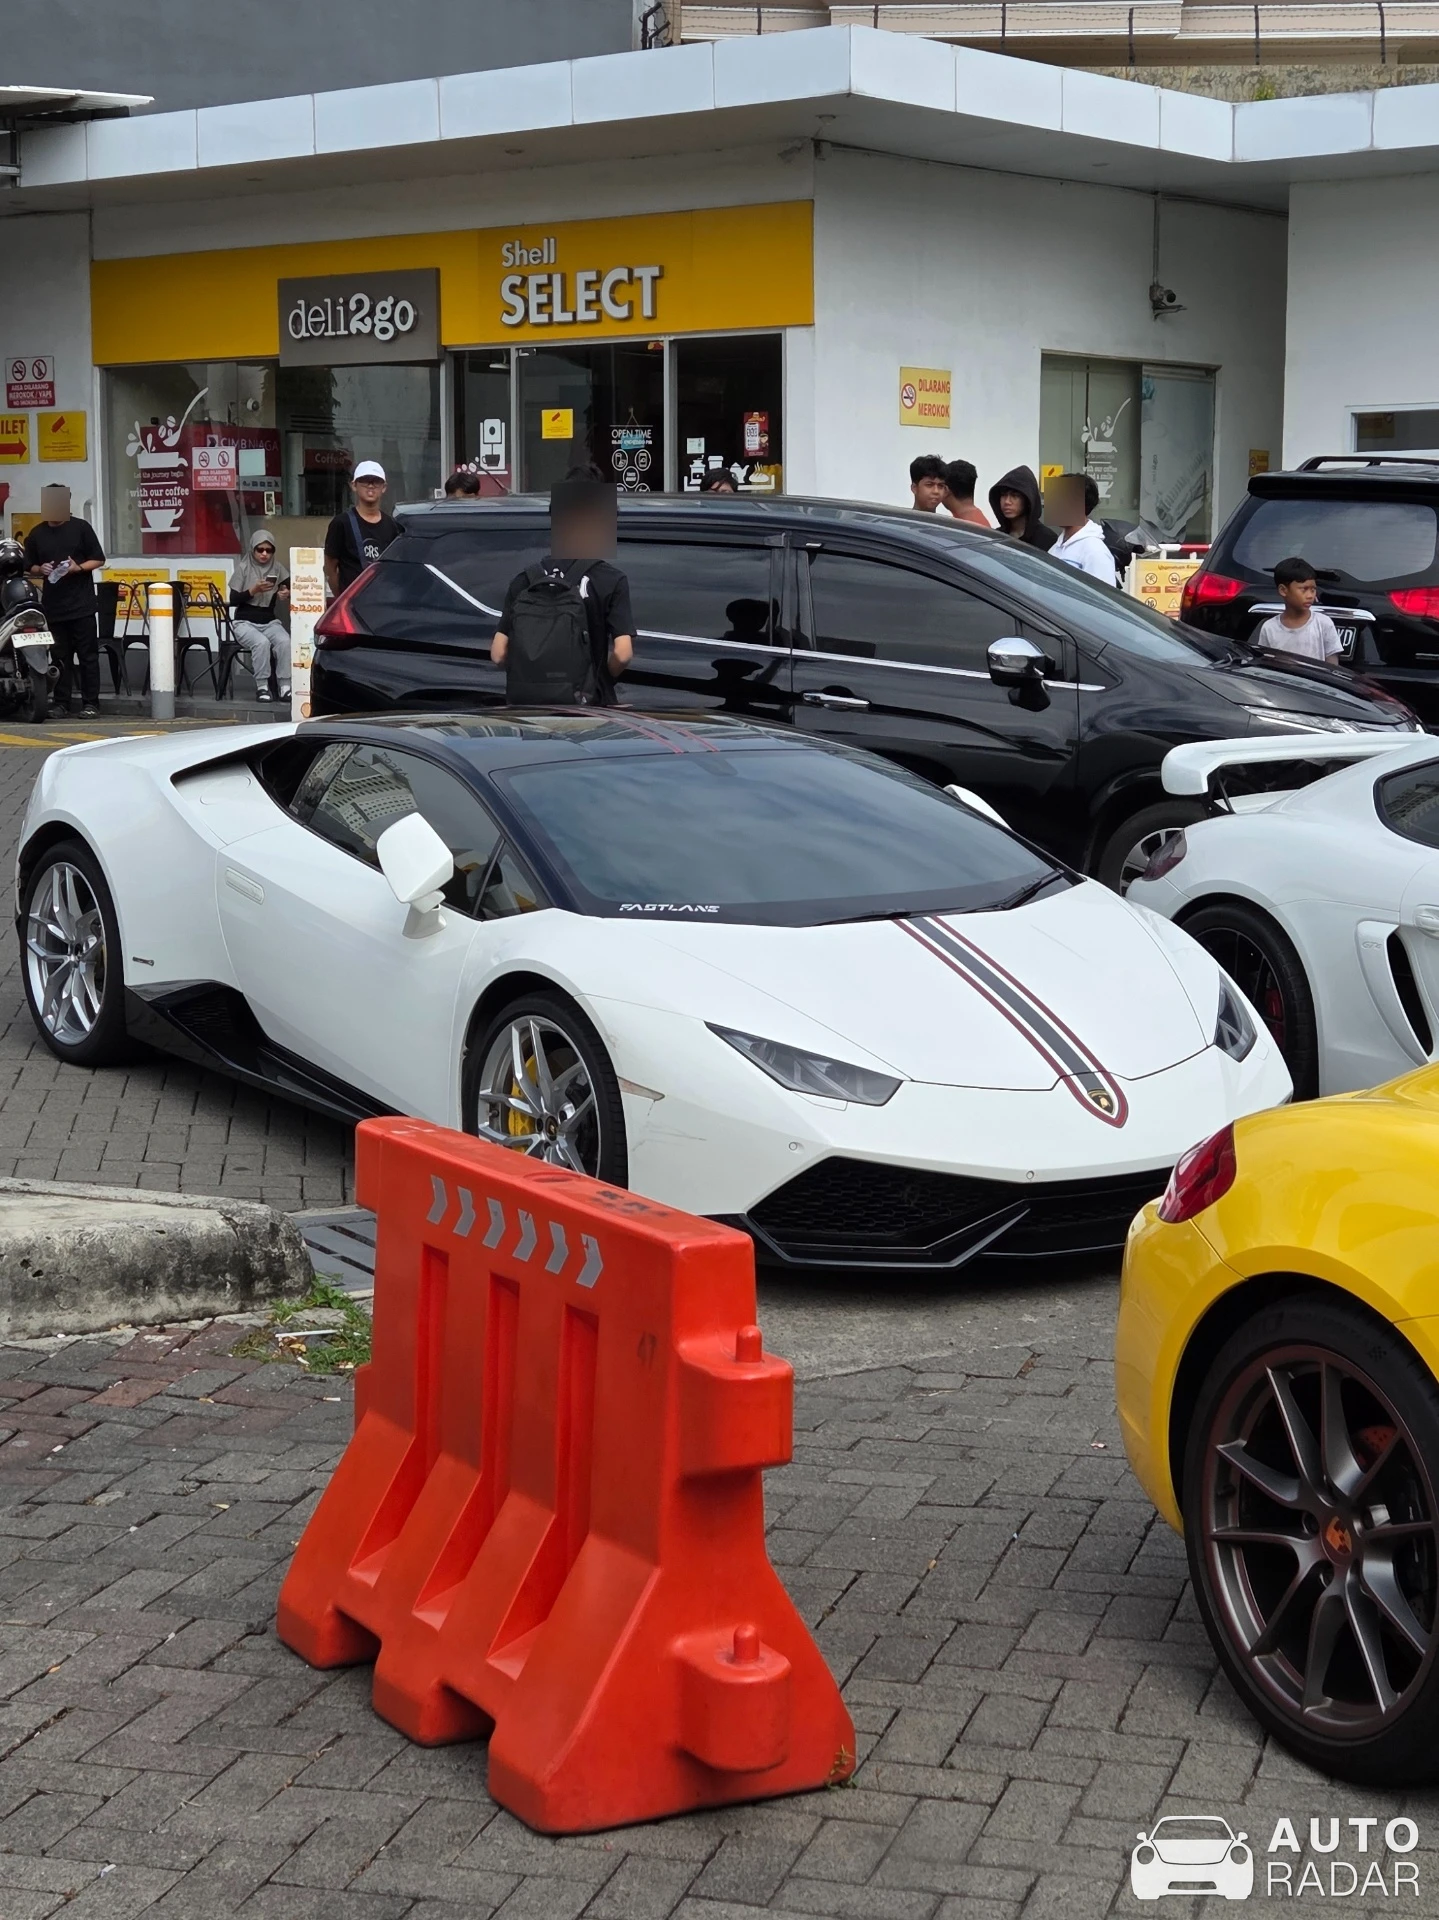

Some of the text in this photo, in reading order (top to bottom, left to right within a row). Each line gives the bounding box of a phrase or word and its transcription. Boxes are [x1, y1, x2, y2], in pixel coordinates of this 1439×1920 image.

[501, 237, 556, 268] Shell
[500, 265, 664, 326] SELECT
[288, 292, 415, 341] deli2go
[918, 378, 950, 394] DILARANG
[918, 402, 950, 418] MEROKOK
[0, 419, 26, 435] ILET
[611, 429, 652, 439] OPEN TIME
[151, 471, 170, 480] journey
[130, 486, 190, 497] with our coffee
[137, 497, 183, 508] and a smile
[619, 903, 720, 913] FASTLANE
